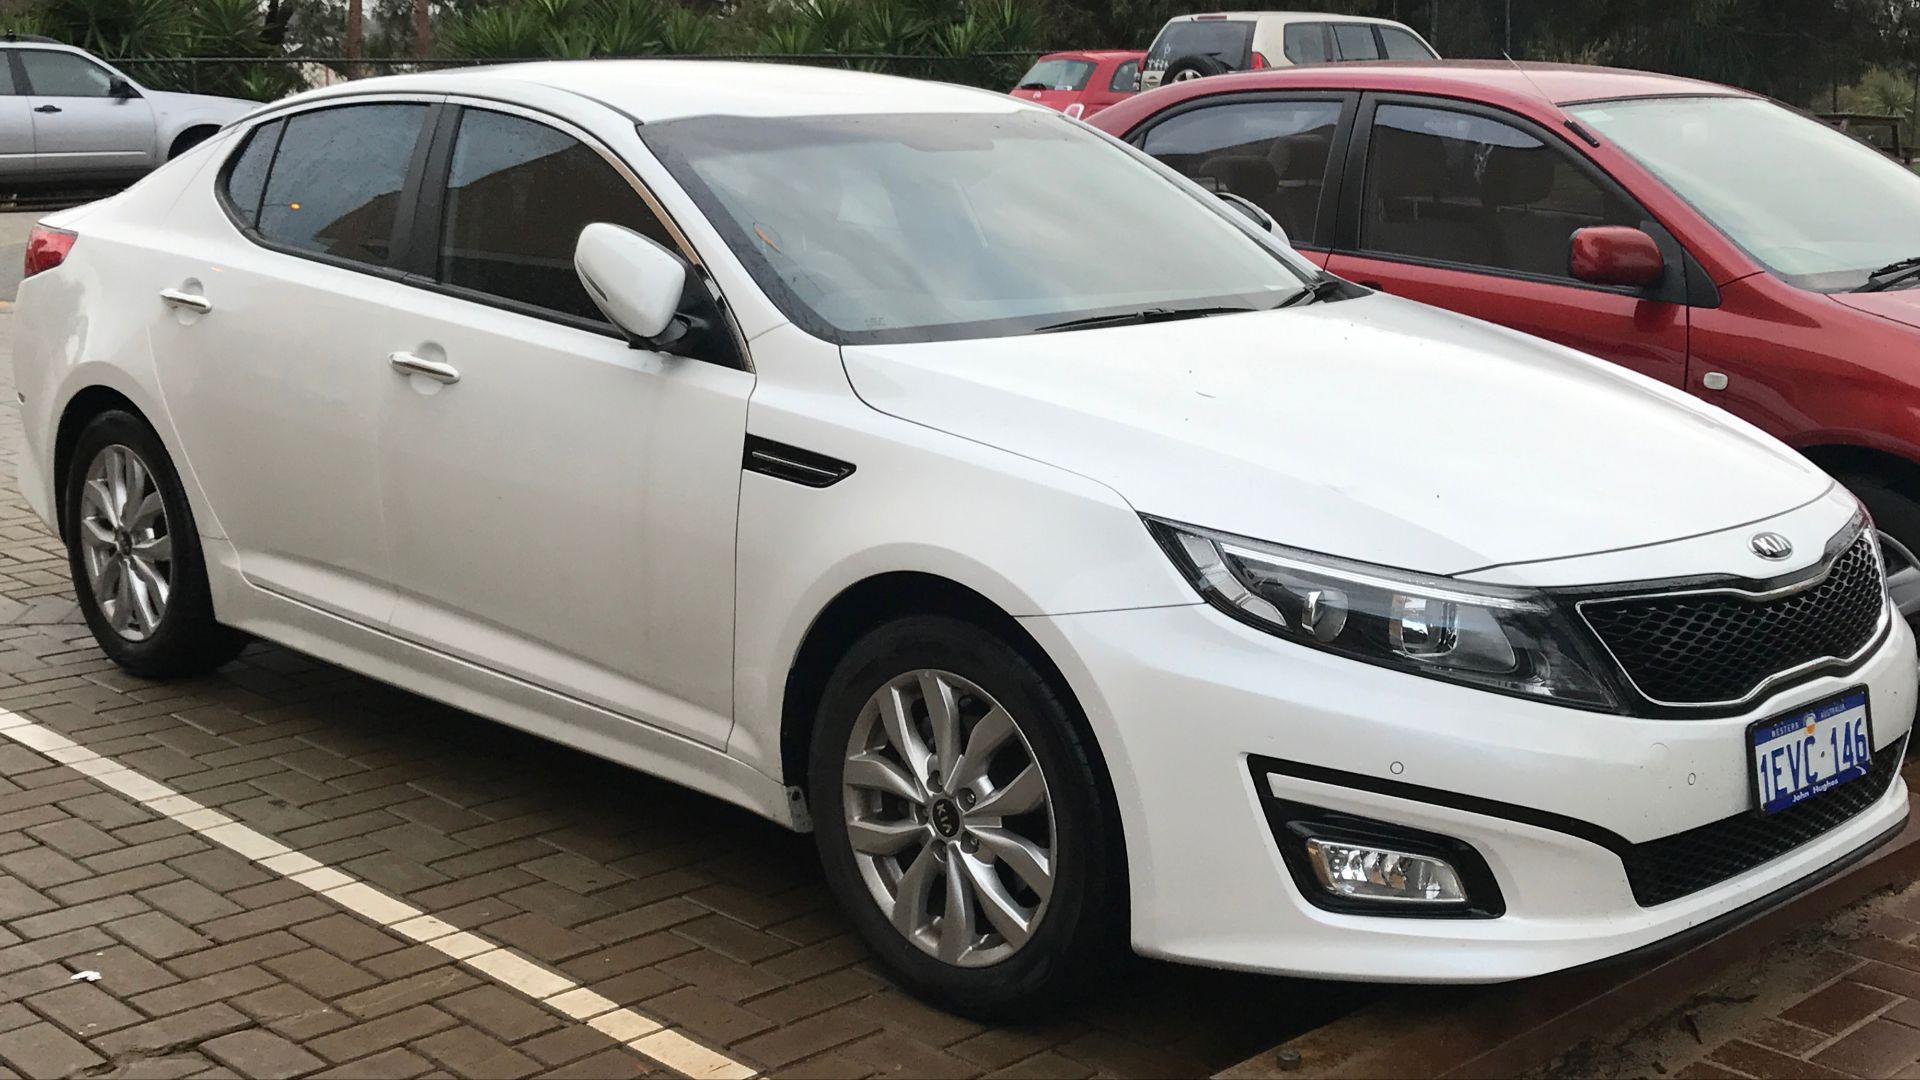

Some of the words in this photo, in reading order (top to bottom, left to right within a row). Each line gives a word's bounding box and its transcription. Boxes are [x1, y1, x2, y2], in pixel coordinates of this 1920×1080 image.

[1753, 534, 1791, 555] KIA
[1771, 722, 1799, 738] WESTERN
[1792, 791, 1810, 803] John
[1812, 778, 1839, 794] Hughes
[936, 803, 953, 834] KIA
